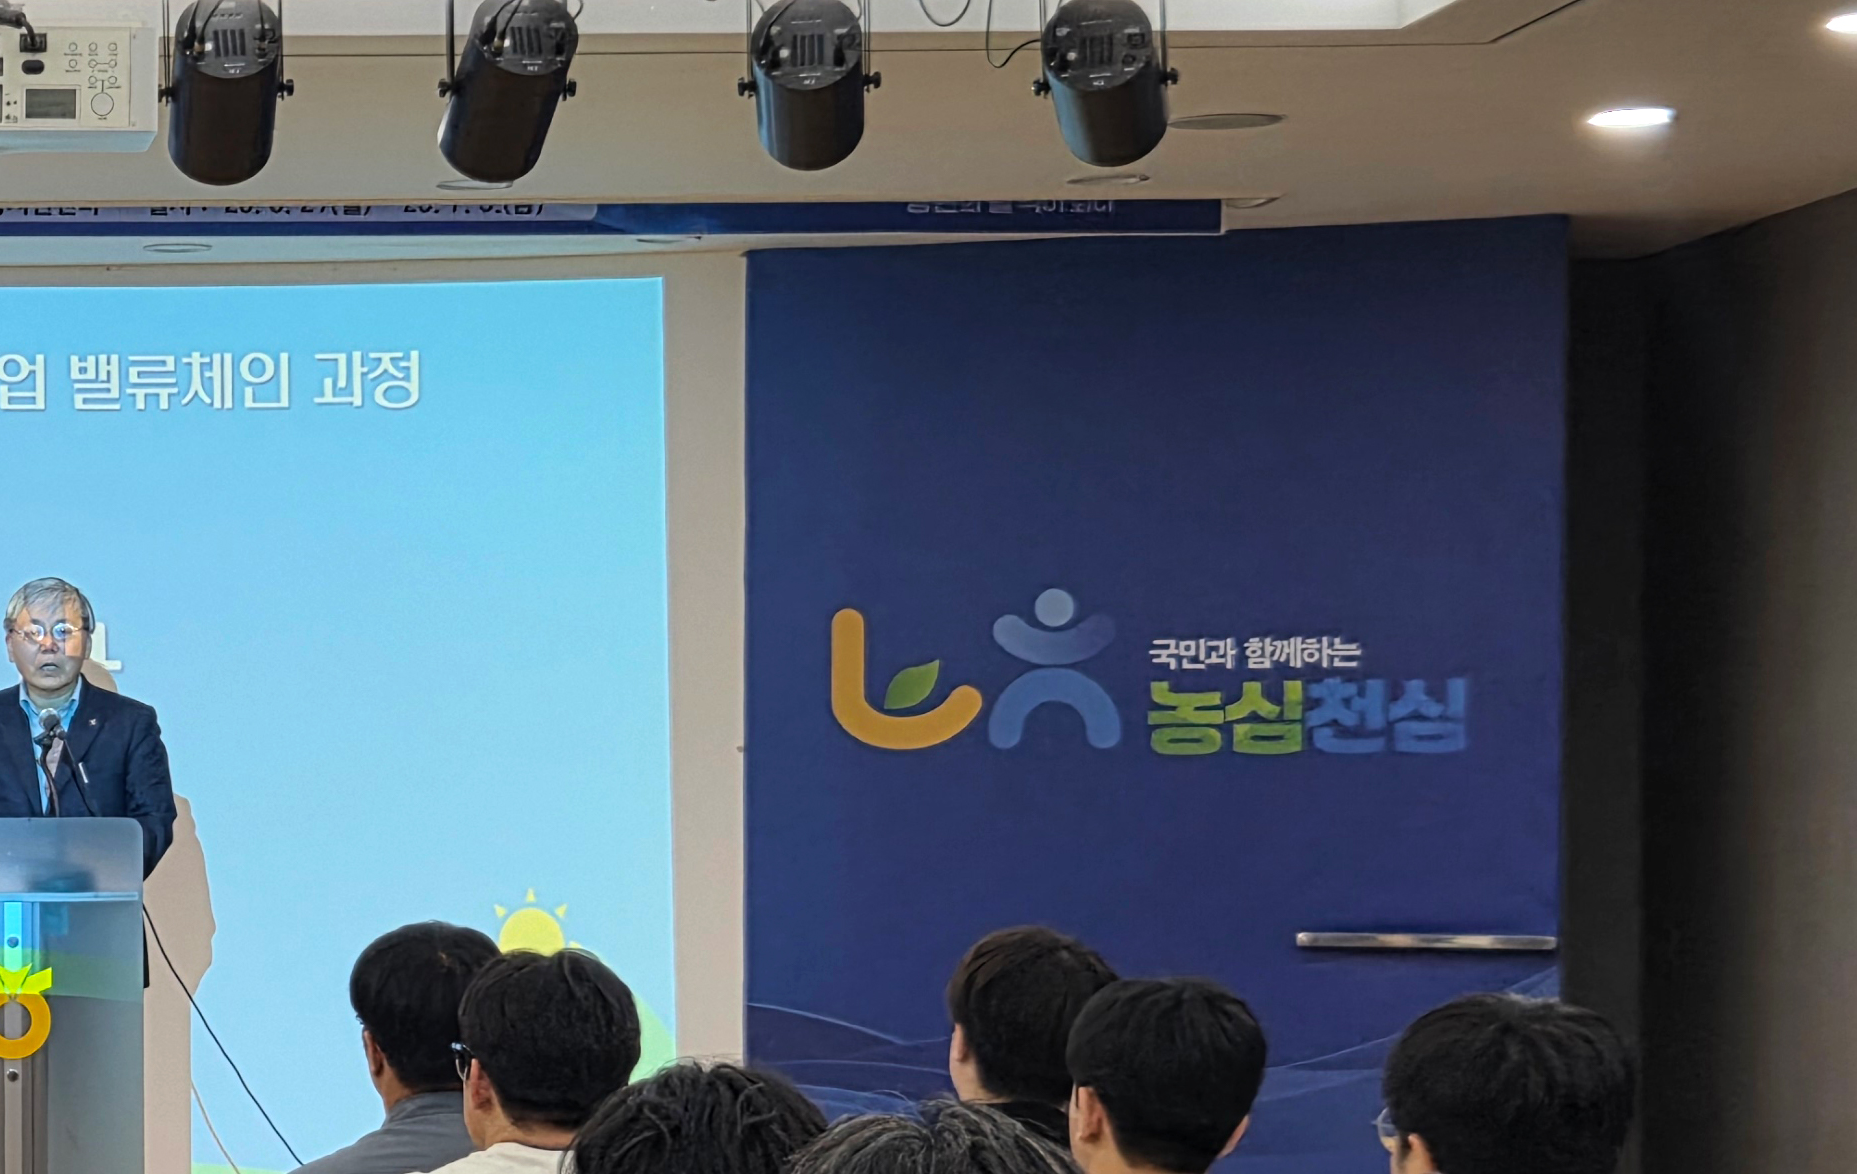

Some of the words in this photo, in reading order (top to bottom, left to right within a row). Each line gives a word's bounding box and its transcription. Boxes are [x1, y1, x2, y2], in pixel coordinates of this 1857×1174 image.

[69, 350, 290, 411] 밸류체인
[313, 349, 422, 408] 과정
[1147, 637, 1237, 670] 국민과
[1243, 636, 1362, 670] 함께하는
[1147, 676, 1467, 756] 농심천심
